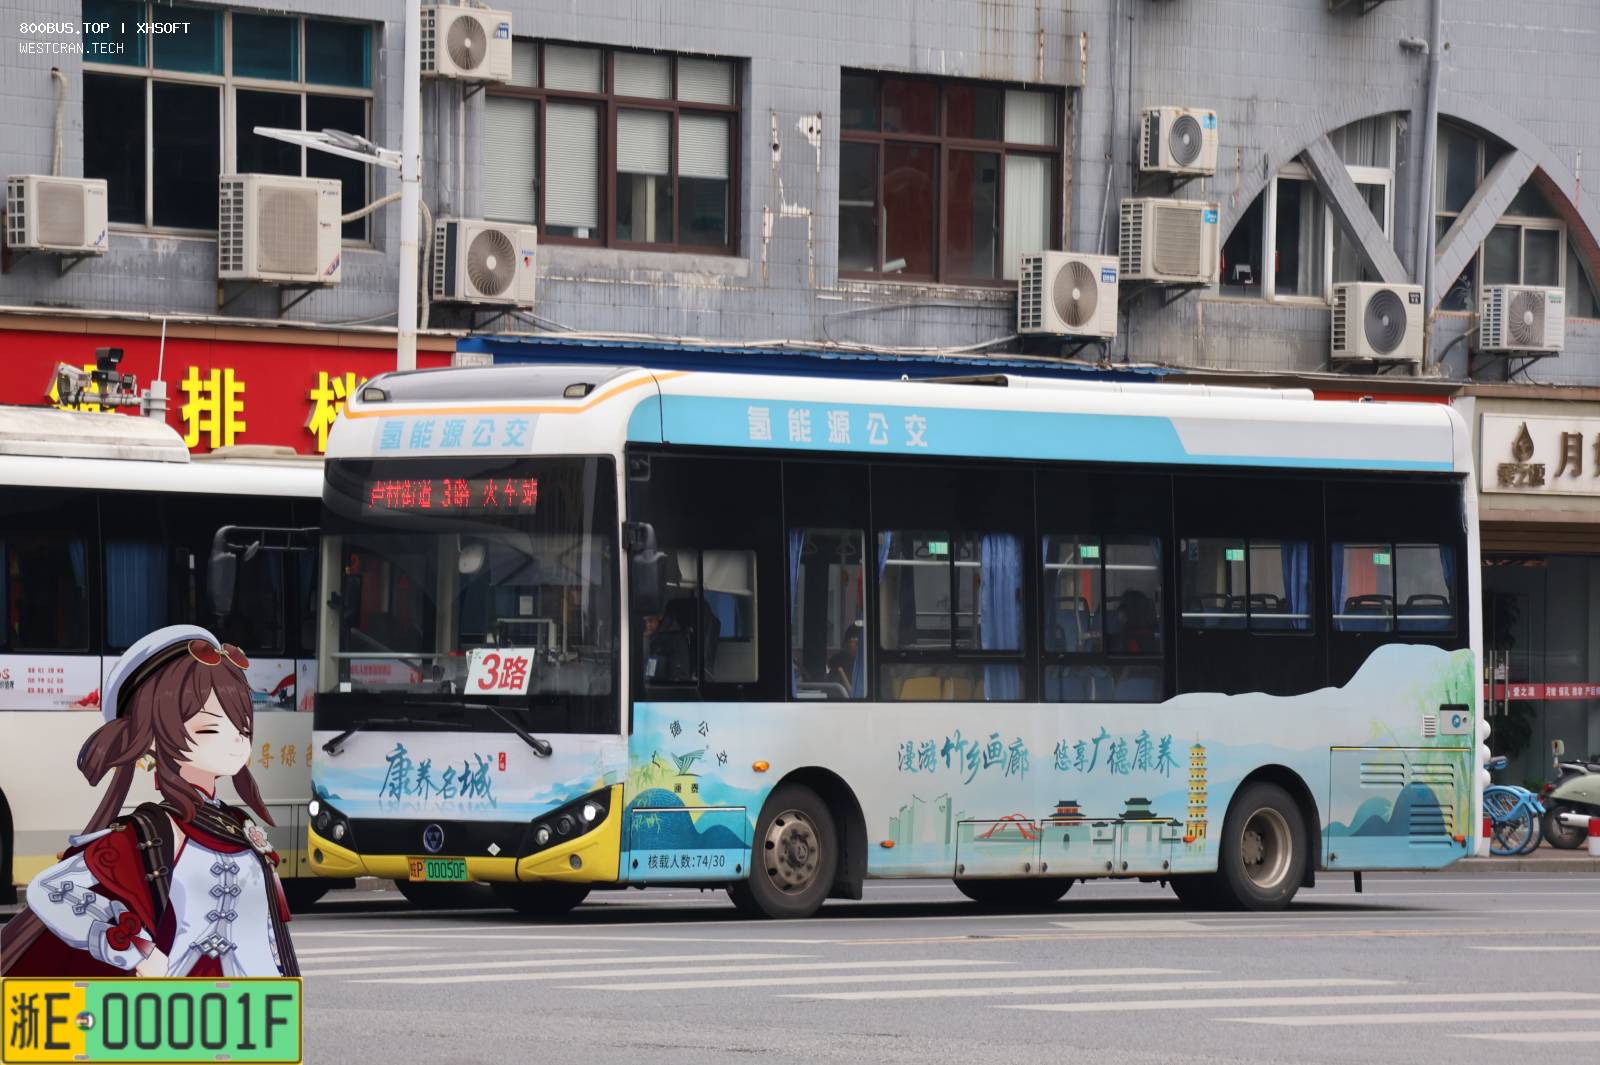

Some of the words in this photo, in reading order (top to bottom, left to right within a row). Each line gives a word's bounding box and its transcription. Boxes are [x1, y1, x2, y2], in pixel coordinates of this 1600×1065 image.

[379, 418, 529, 450] 氢能源公交
[747, 405, 928, 448] 氢能源公交
[1553, 431, 1600, 479] 月
[477, 652, 529, 691] 3路
[378, 742, 497, 809] 康养名城
[897, 728, 1030, 786] 漫游竹乡画廊
[1053, 725, 1181, 778] 悠享广德康养
